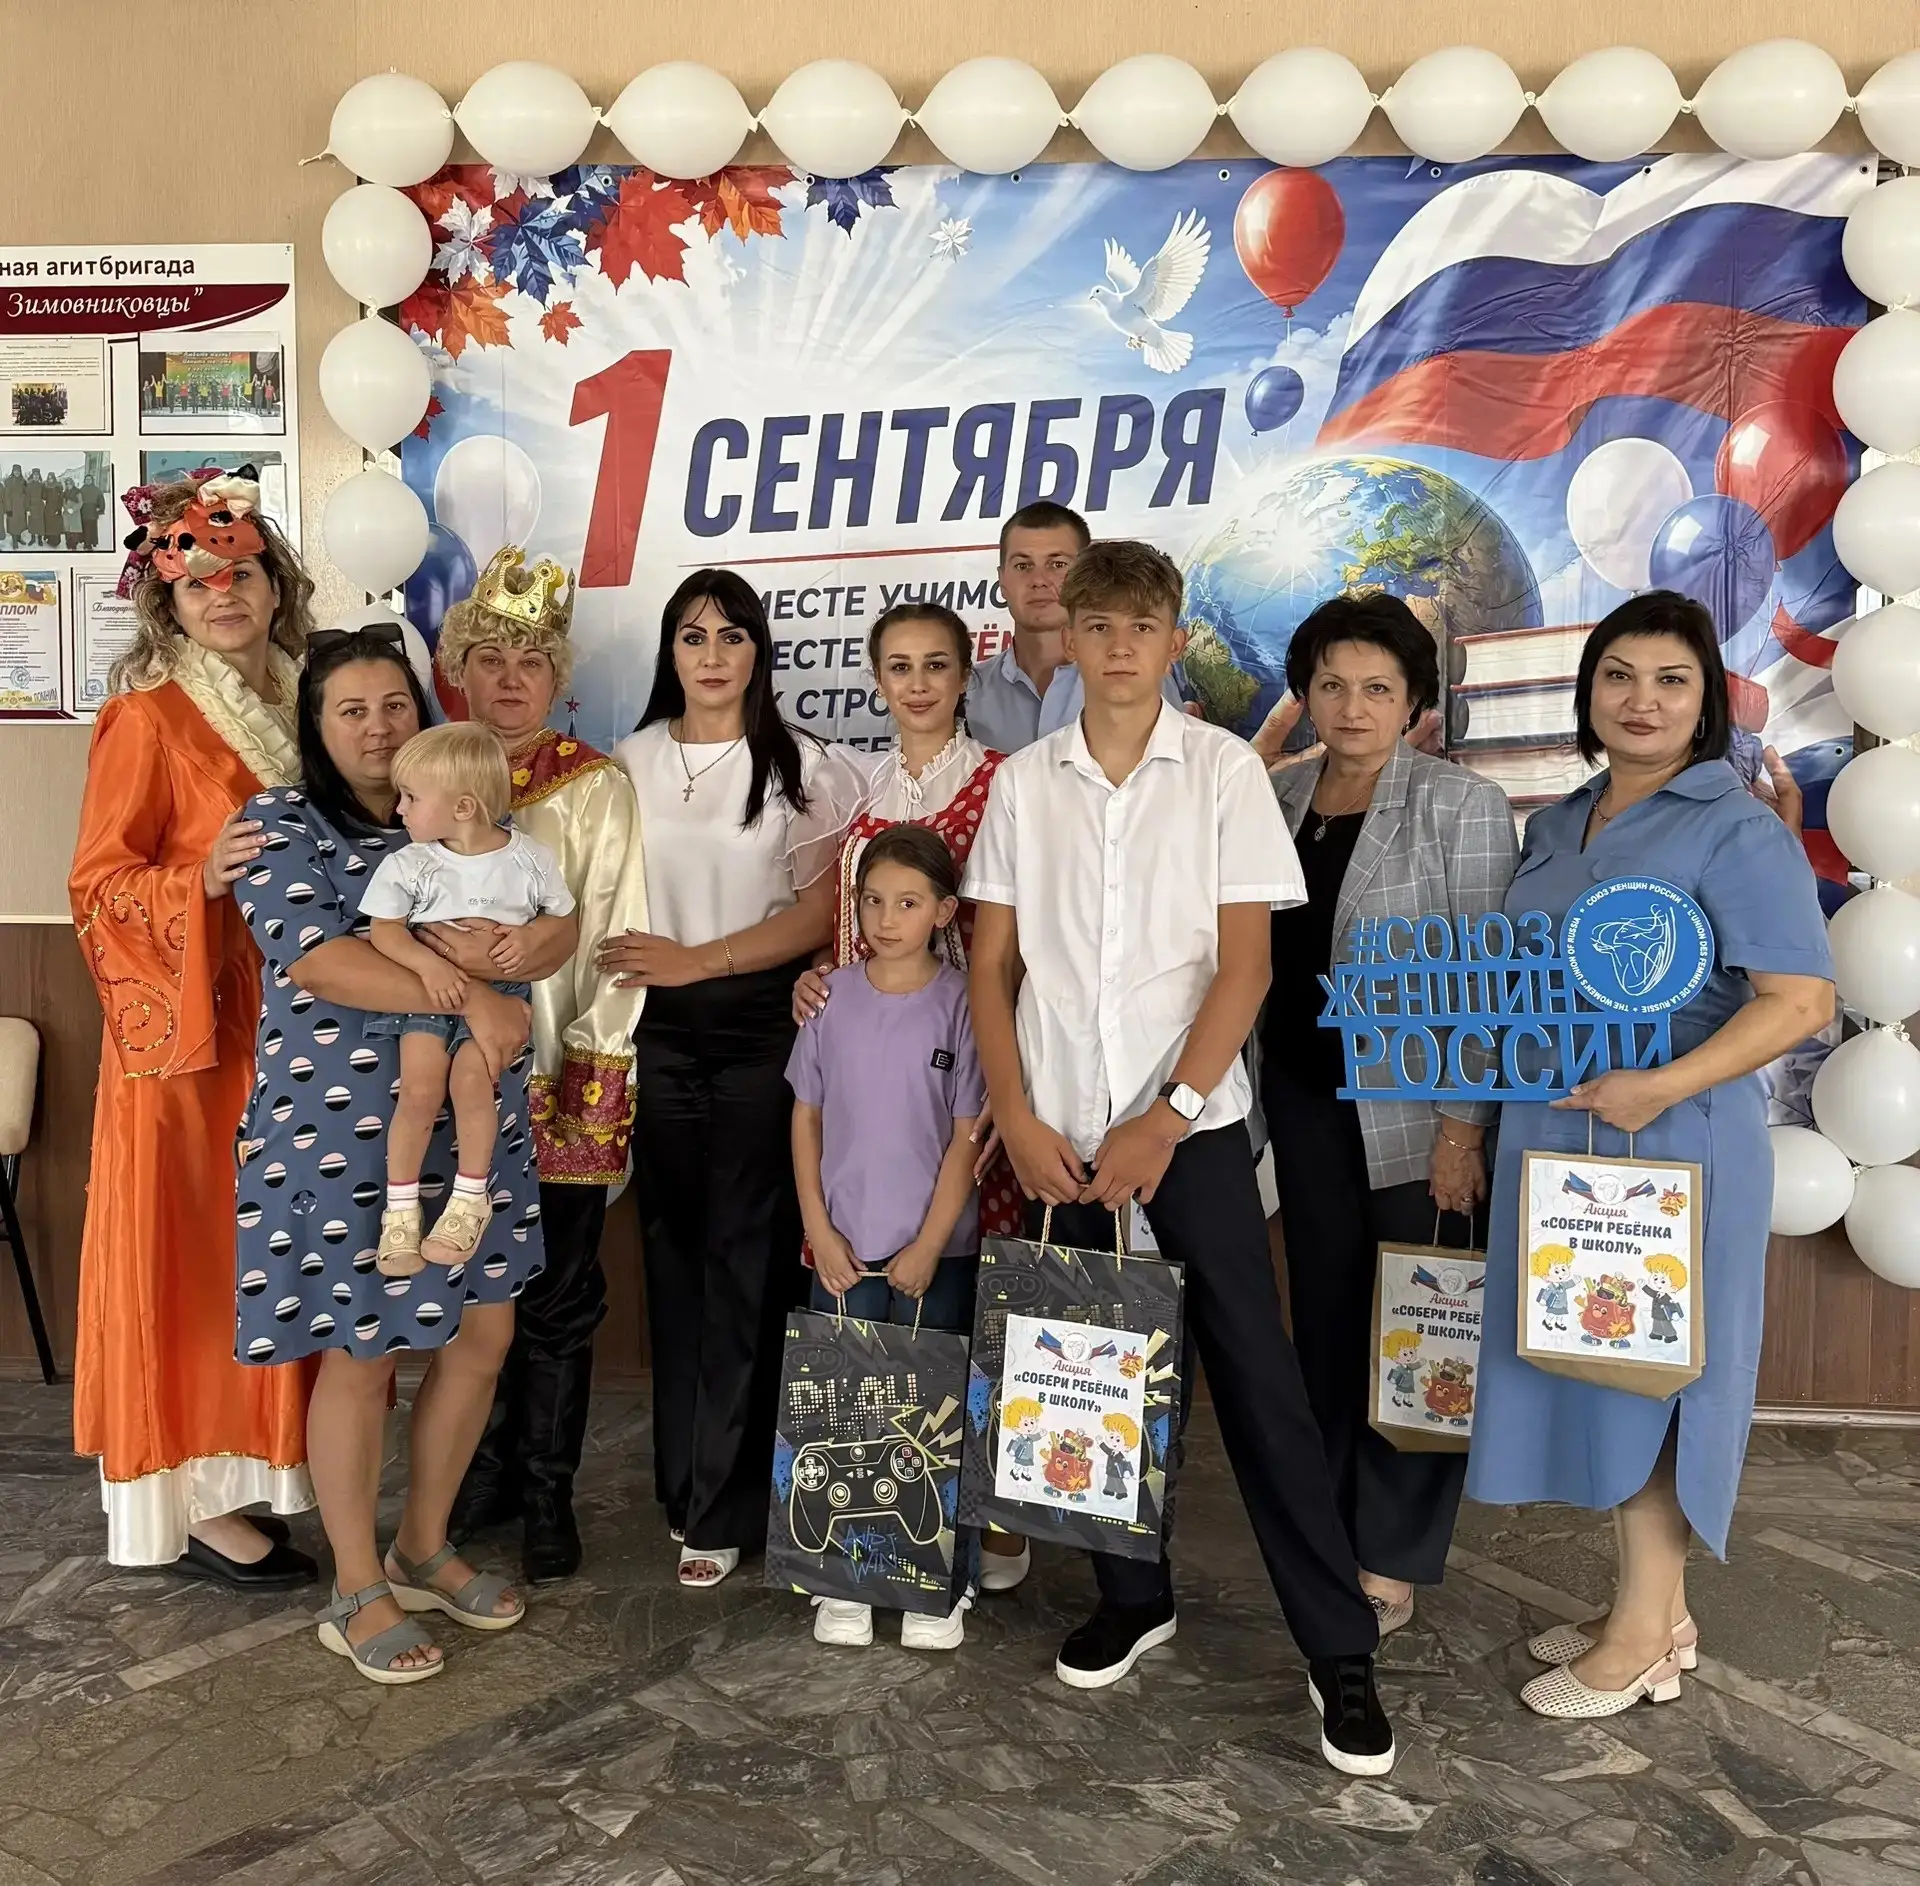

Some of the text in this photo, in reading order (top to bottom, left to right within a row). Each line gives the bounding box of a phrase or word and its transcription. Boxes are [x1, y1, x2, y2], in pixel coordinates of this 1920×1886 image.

[0, 255, 195, 280] ная агитбригада
[569, 349, 1226, 588] 1 СЕНТЯБРЯ
[1586, 882, 1682, 907] СОЮЗ ЖЕНЩИН РОССИИ
[1348, 910, 1555, 964] #СОЮЗ
[1567, 917, 1629, 1012] THE WOMEN'S UNION OF RUSSIA
[1641, 908, 1708, 1014] L'UNION DES FEMMES DE LA RUSSIE
[1316, 967, 1577, 1017] ЖЕНЩИН
[1341, 1022, 1673, 1092] РОССИИ
[1583, 1203, 1628, 1218] Акция
[1541, 1217, 1672, 1239] «СОБЕРИ РЕБЁНКА
[1569, 1237, 1642, 1255] В ШКОЛУ»
[1430, 1293, 1469, 1308] Акция
[1392, 1304, 1480, 1325] «СОБЕРИ РЕБЁ
[1417, 1323, 1480, 1342] В ШКОЛУ»
[1052, 1360, 1092, 1376] Акция
[1014, 1371, 1129, 1400] «СОБЕРИ РЕБЁНКА
[1038, 1391, 1101, 1413] В ШКОЛУ»
